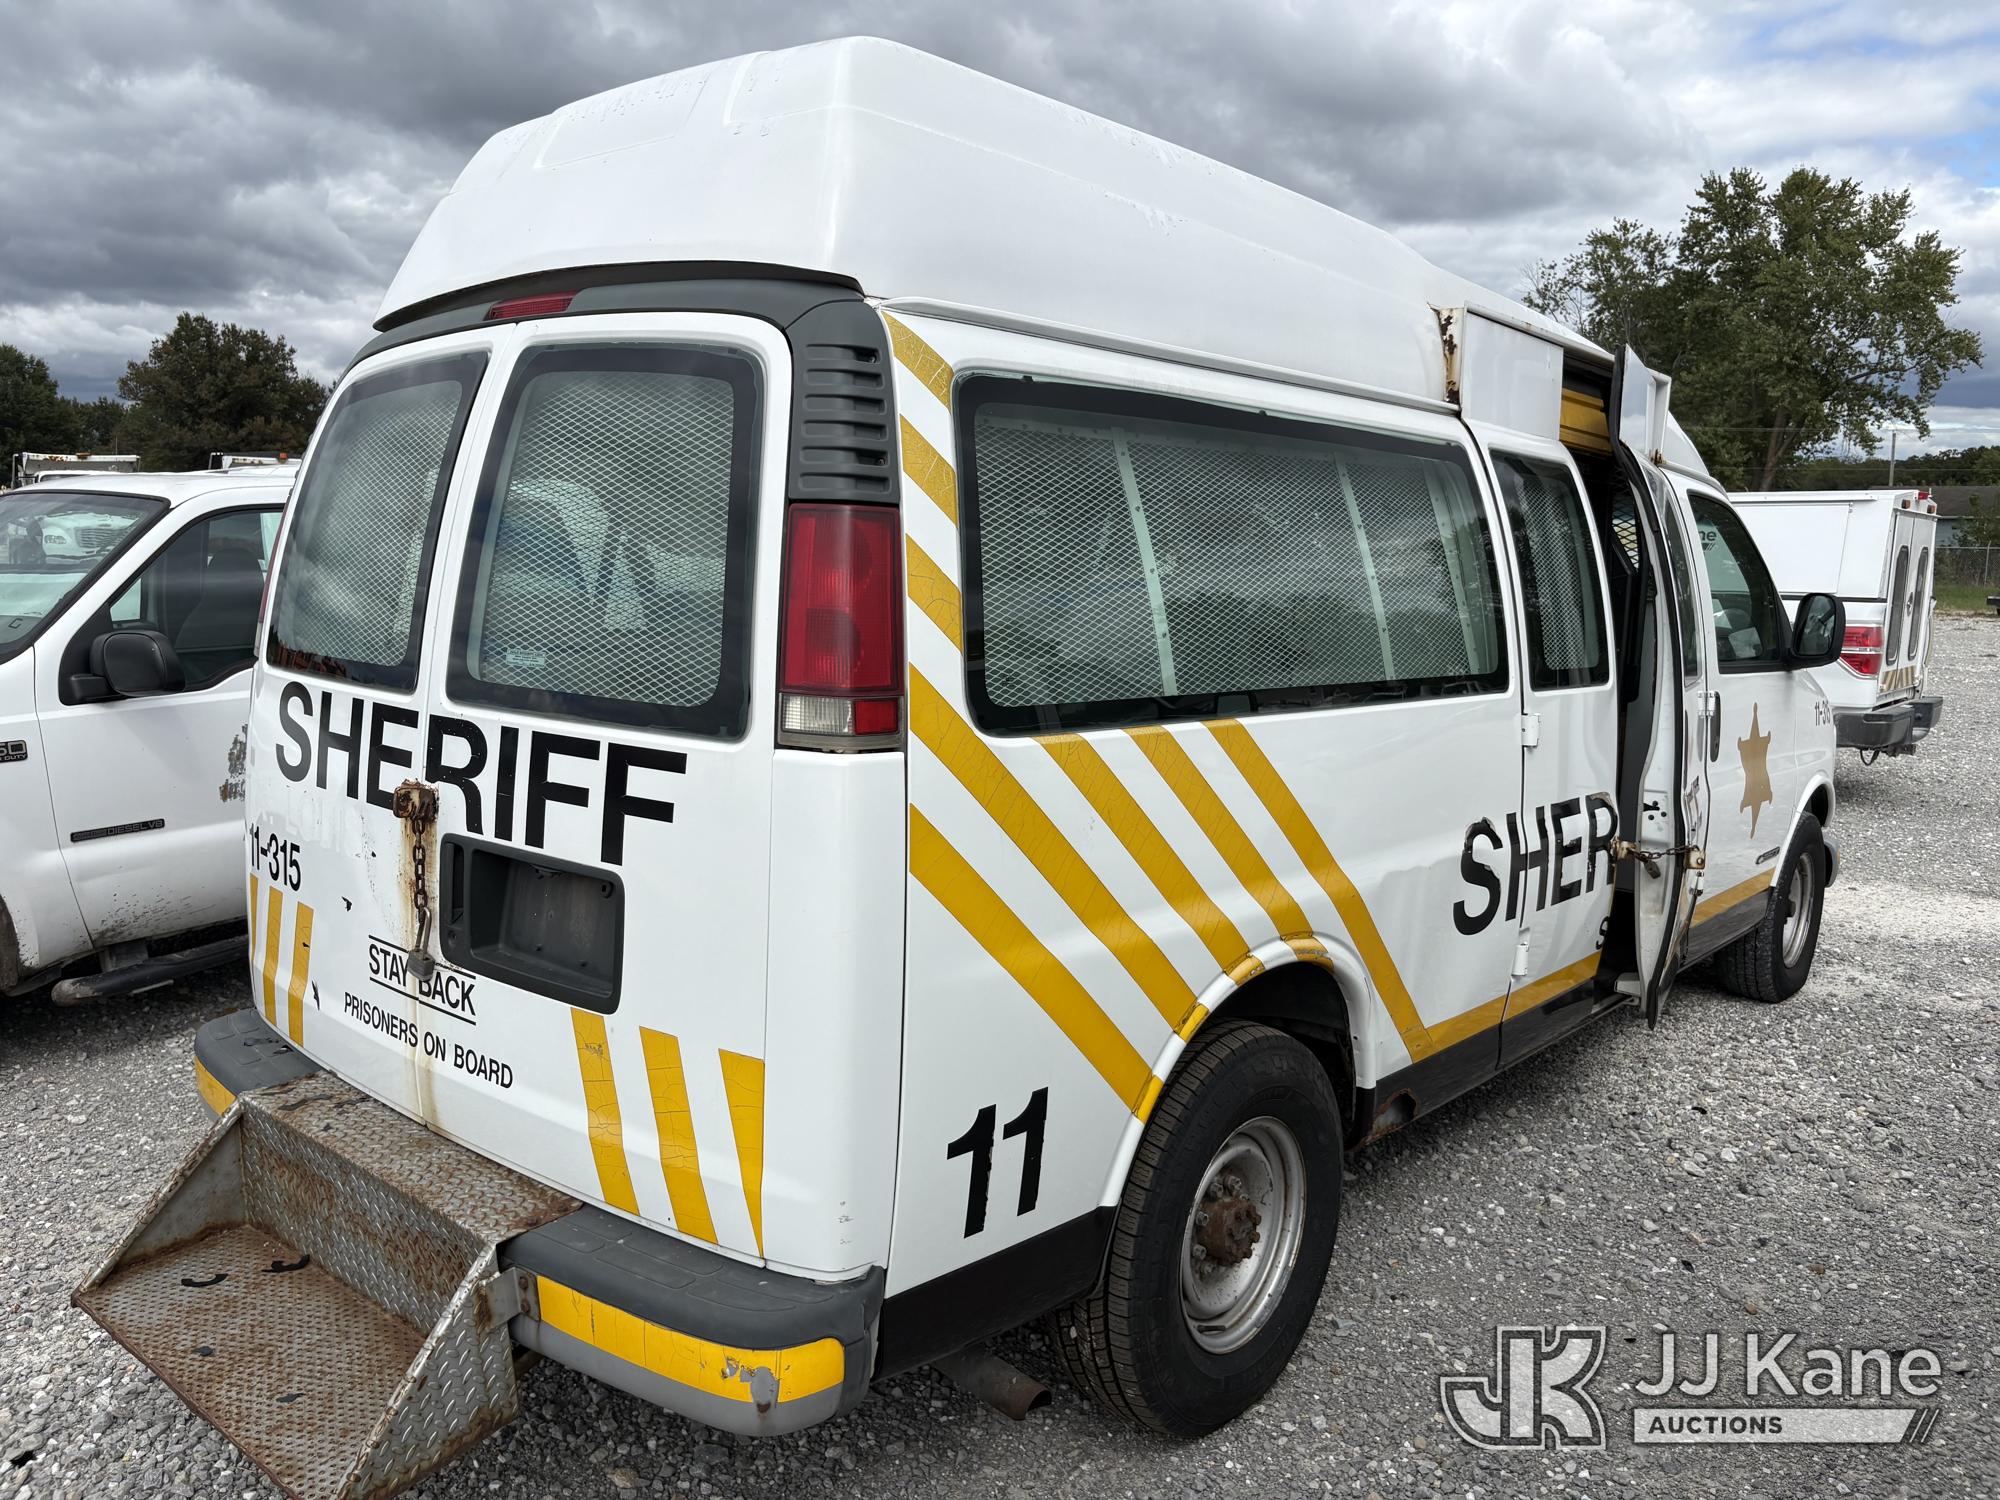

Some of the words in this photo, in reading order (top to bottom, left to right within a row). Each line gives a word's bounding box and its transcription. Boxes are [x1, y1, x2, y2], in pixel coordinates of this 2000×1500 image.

[274, 681, 688, 866] SHERIFF
[107, 822, 147, 836] DIESEL
[249, 822, 301, 892] 11-315
[1452, 791, 1619, 936] SHER
[369, 943, 409, 987] STAY
[344, 992, 418, 1048] PRISONERS
[423, 1031, 446, 1062] ON
[453, 1043, 513, 1089] BOARD
[946, 1086, 1049, 1238] 11
